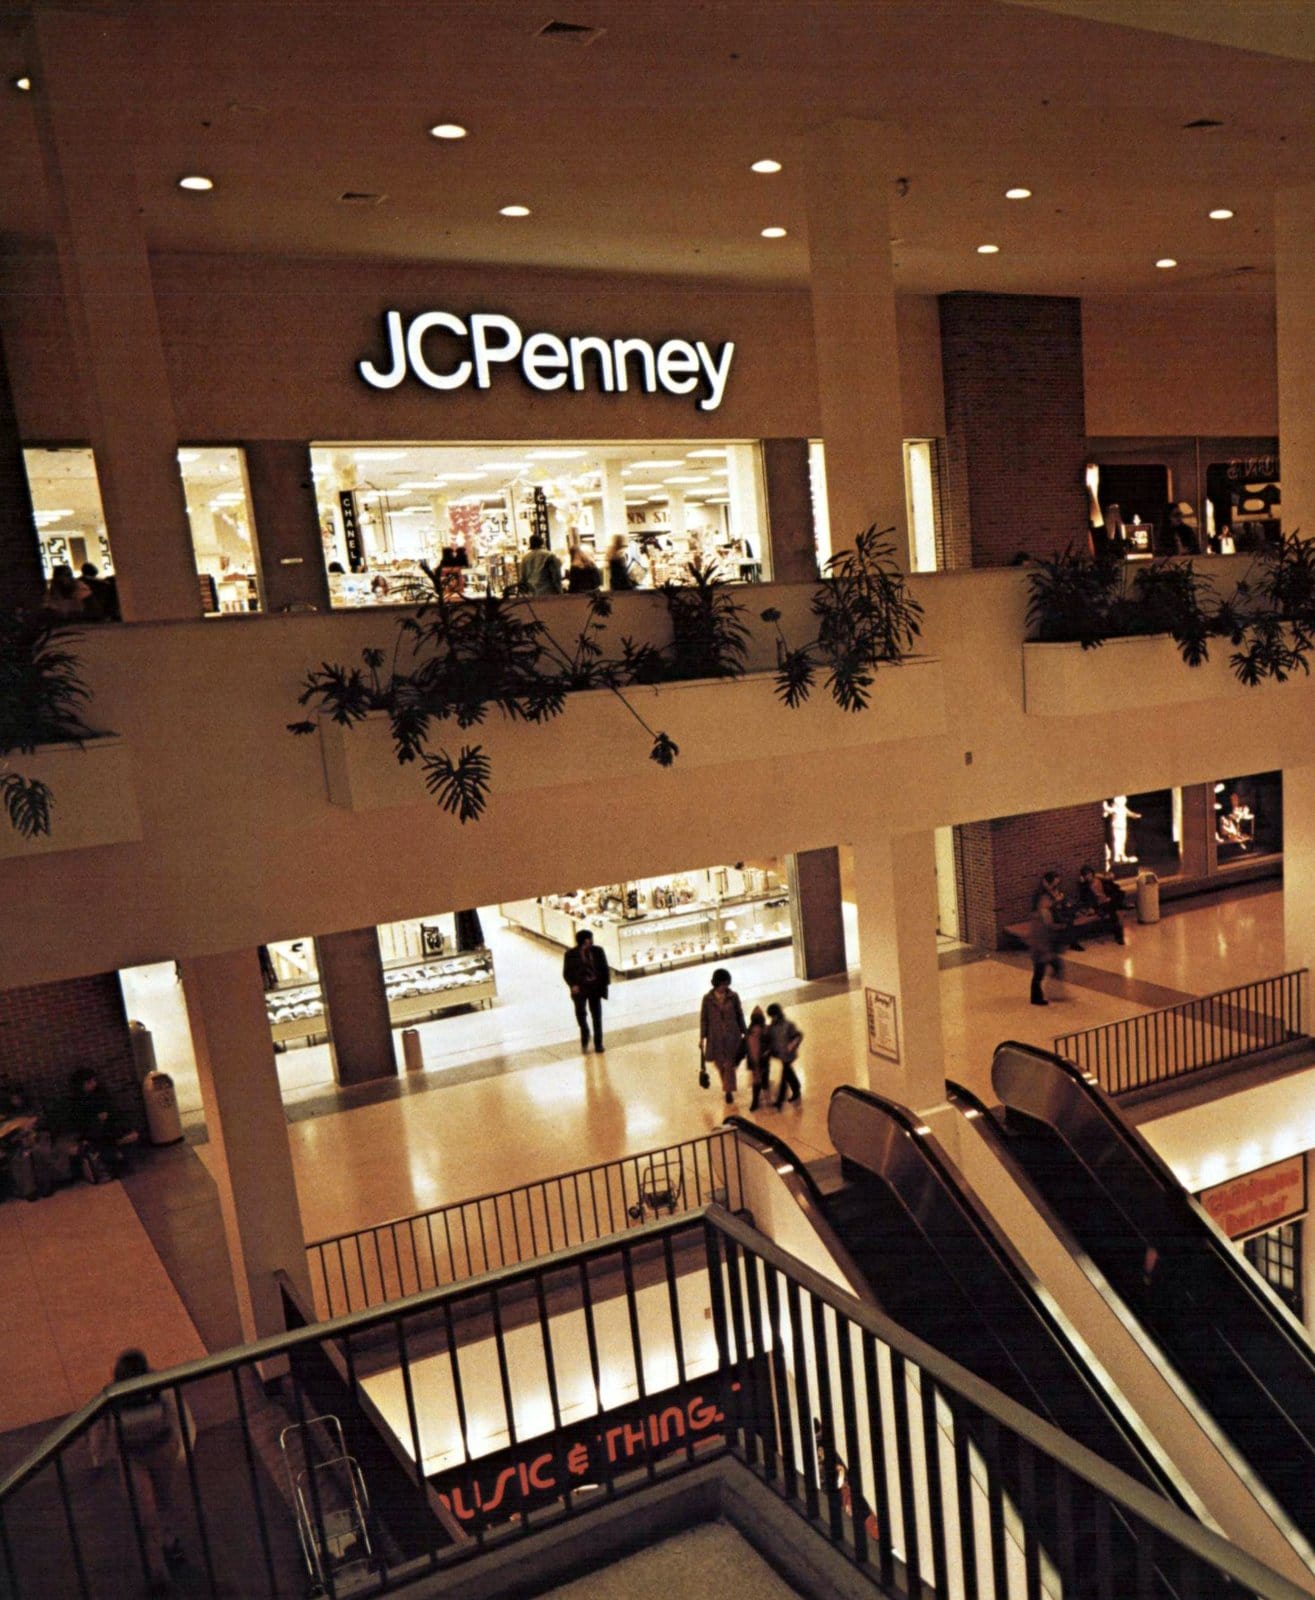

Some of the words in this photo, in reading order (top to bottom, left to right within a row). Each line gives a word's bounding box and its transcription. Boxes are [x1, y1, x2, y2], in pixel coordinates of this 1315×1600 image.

[359, 311, 735, 411] JCPenney
[343, 498, 357, 559] CHANEL
[568, 1443, 590, 1476] &
[596, 1384, 742, 1463] THING
